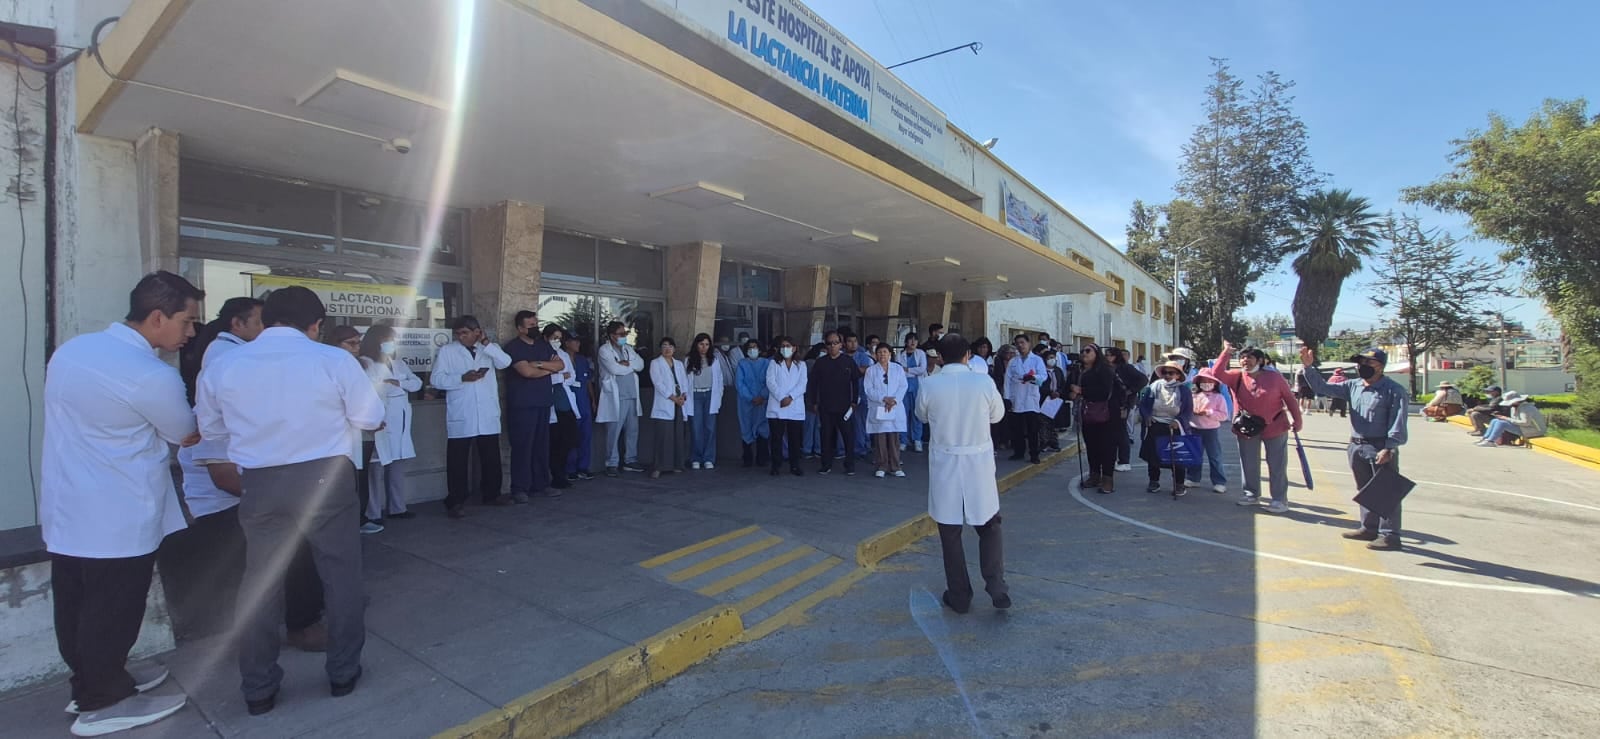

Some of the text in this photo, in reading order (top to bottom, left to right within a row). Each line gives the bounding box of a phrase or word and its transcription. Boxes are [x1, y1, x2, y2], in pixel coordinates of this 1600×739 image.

[728, 10, 868, 122] LA LACTANCIA MATERNA
[778, 4, 829, 63] HOSPITAL
[831, 44, 842, 71] SE
[842, 54, 871, 91] APOYA
[330, 293, 392, 304] LACTARIO
